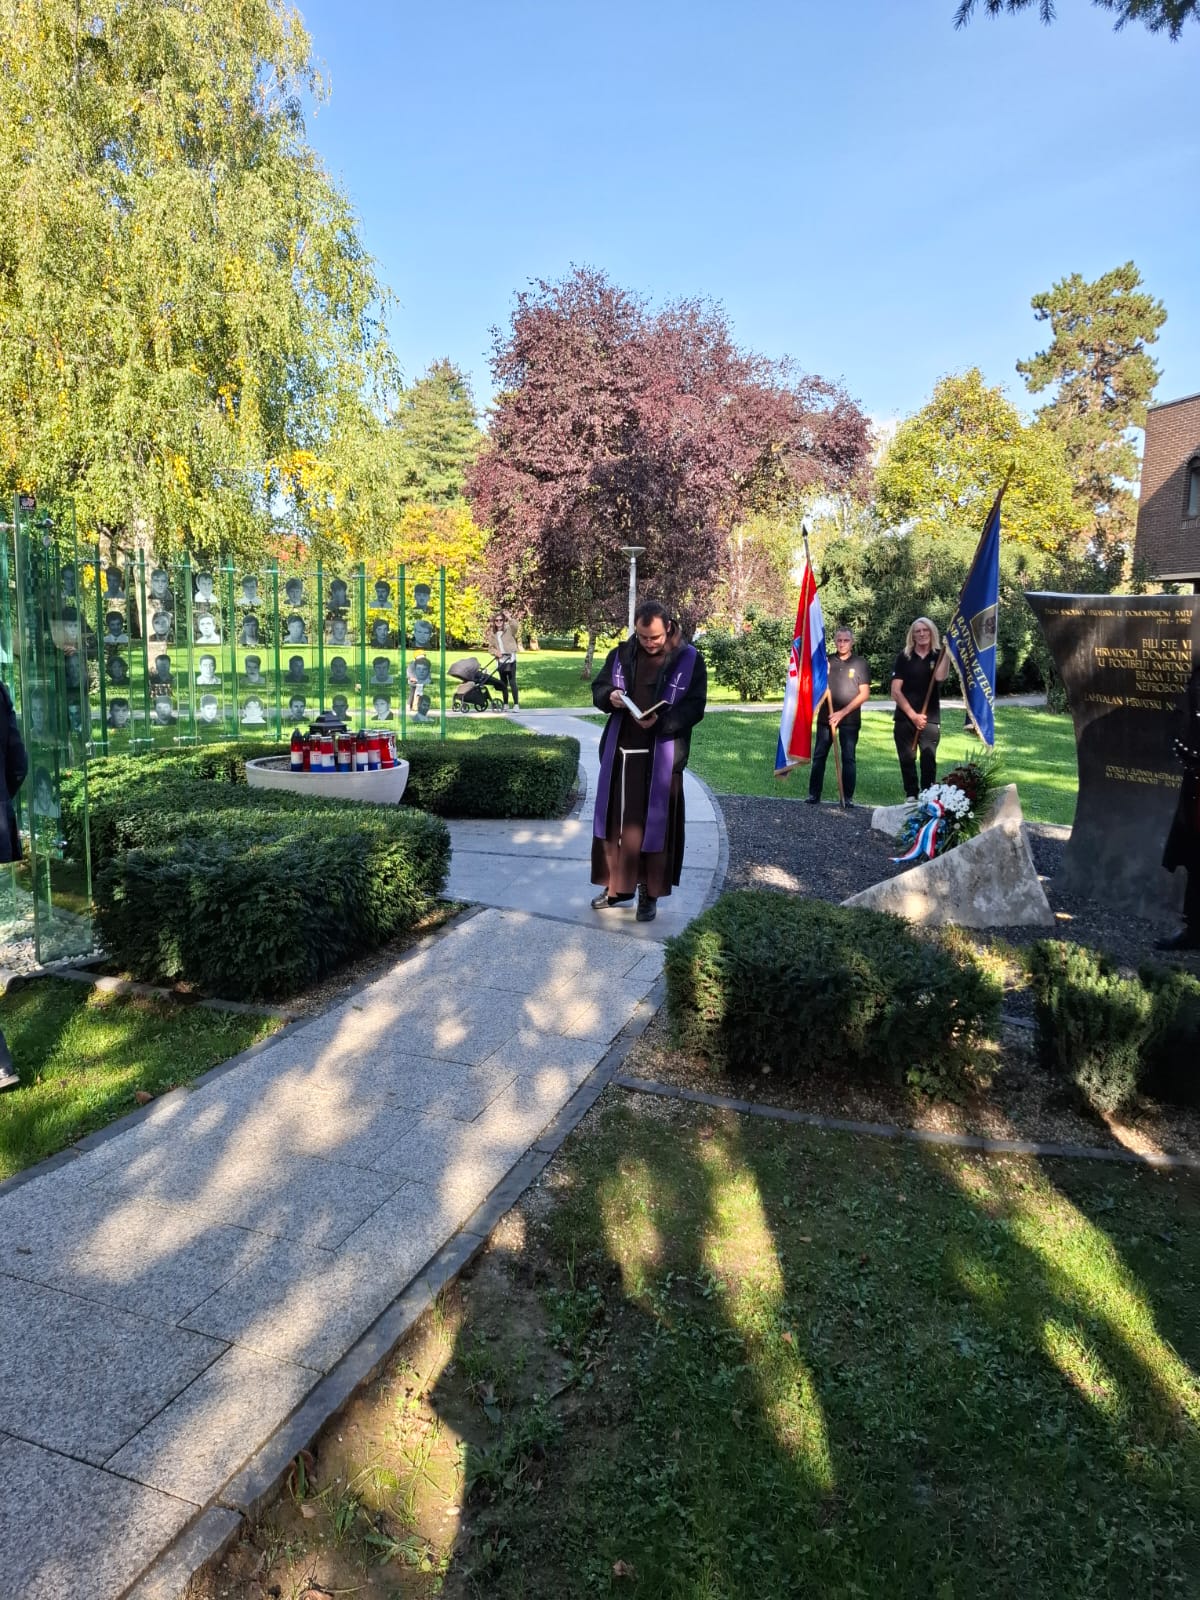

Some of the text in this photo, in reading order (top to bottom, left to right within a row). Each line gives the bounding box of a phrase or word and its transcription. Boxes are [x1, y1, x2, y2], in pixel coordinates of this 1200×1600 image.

[1142, 638, 1192, 650] BILI STE VI
[1095, 648, 1192, 661] HRVATSKOJ DOMOVINI
[1098, 658, 1105, 667] U
[1136, 670, 1164, 682] BRANA
[971, 658, 994, 711] VETERA
